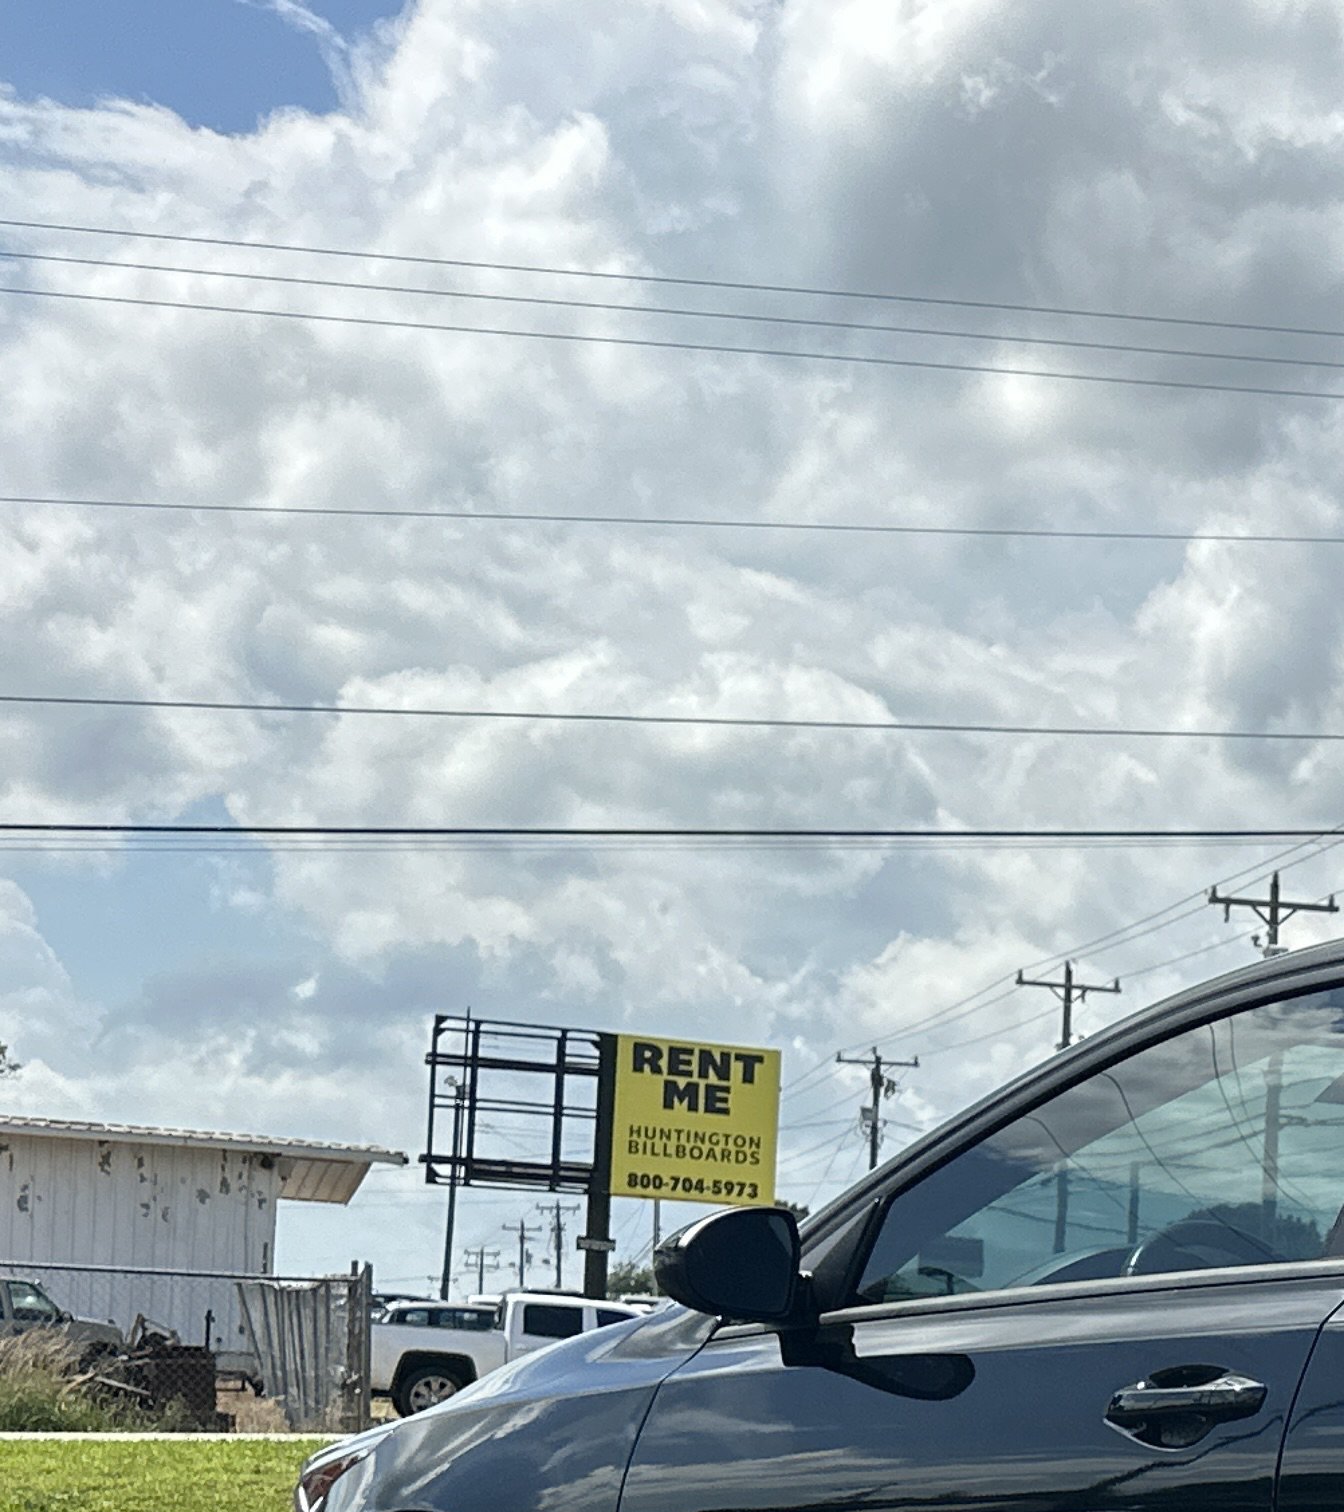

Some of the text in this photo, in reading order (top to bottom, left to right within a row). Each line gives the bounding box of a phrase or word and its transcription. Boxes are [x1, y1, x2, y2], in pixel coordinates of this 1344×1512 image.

[633, 1042, 764, 1084] RENT
[663, 1080, 731, 1115] ME
[629, 1124, 761, 1150] HUNTINGTON
[627, 1139, 760, 1165] BILLBOARDS
[627, 1172, 758, 1199] 800-704-5973
